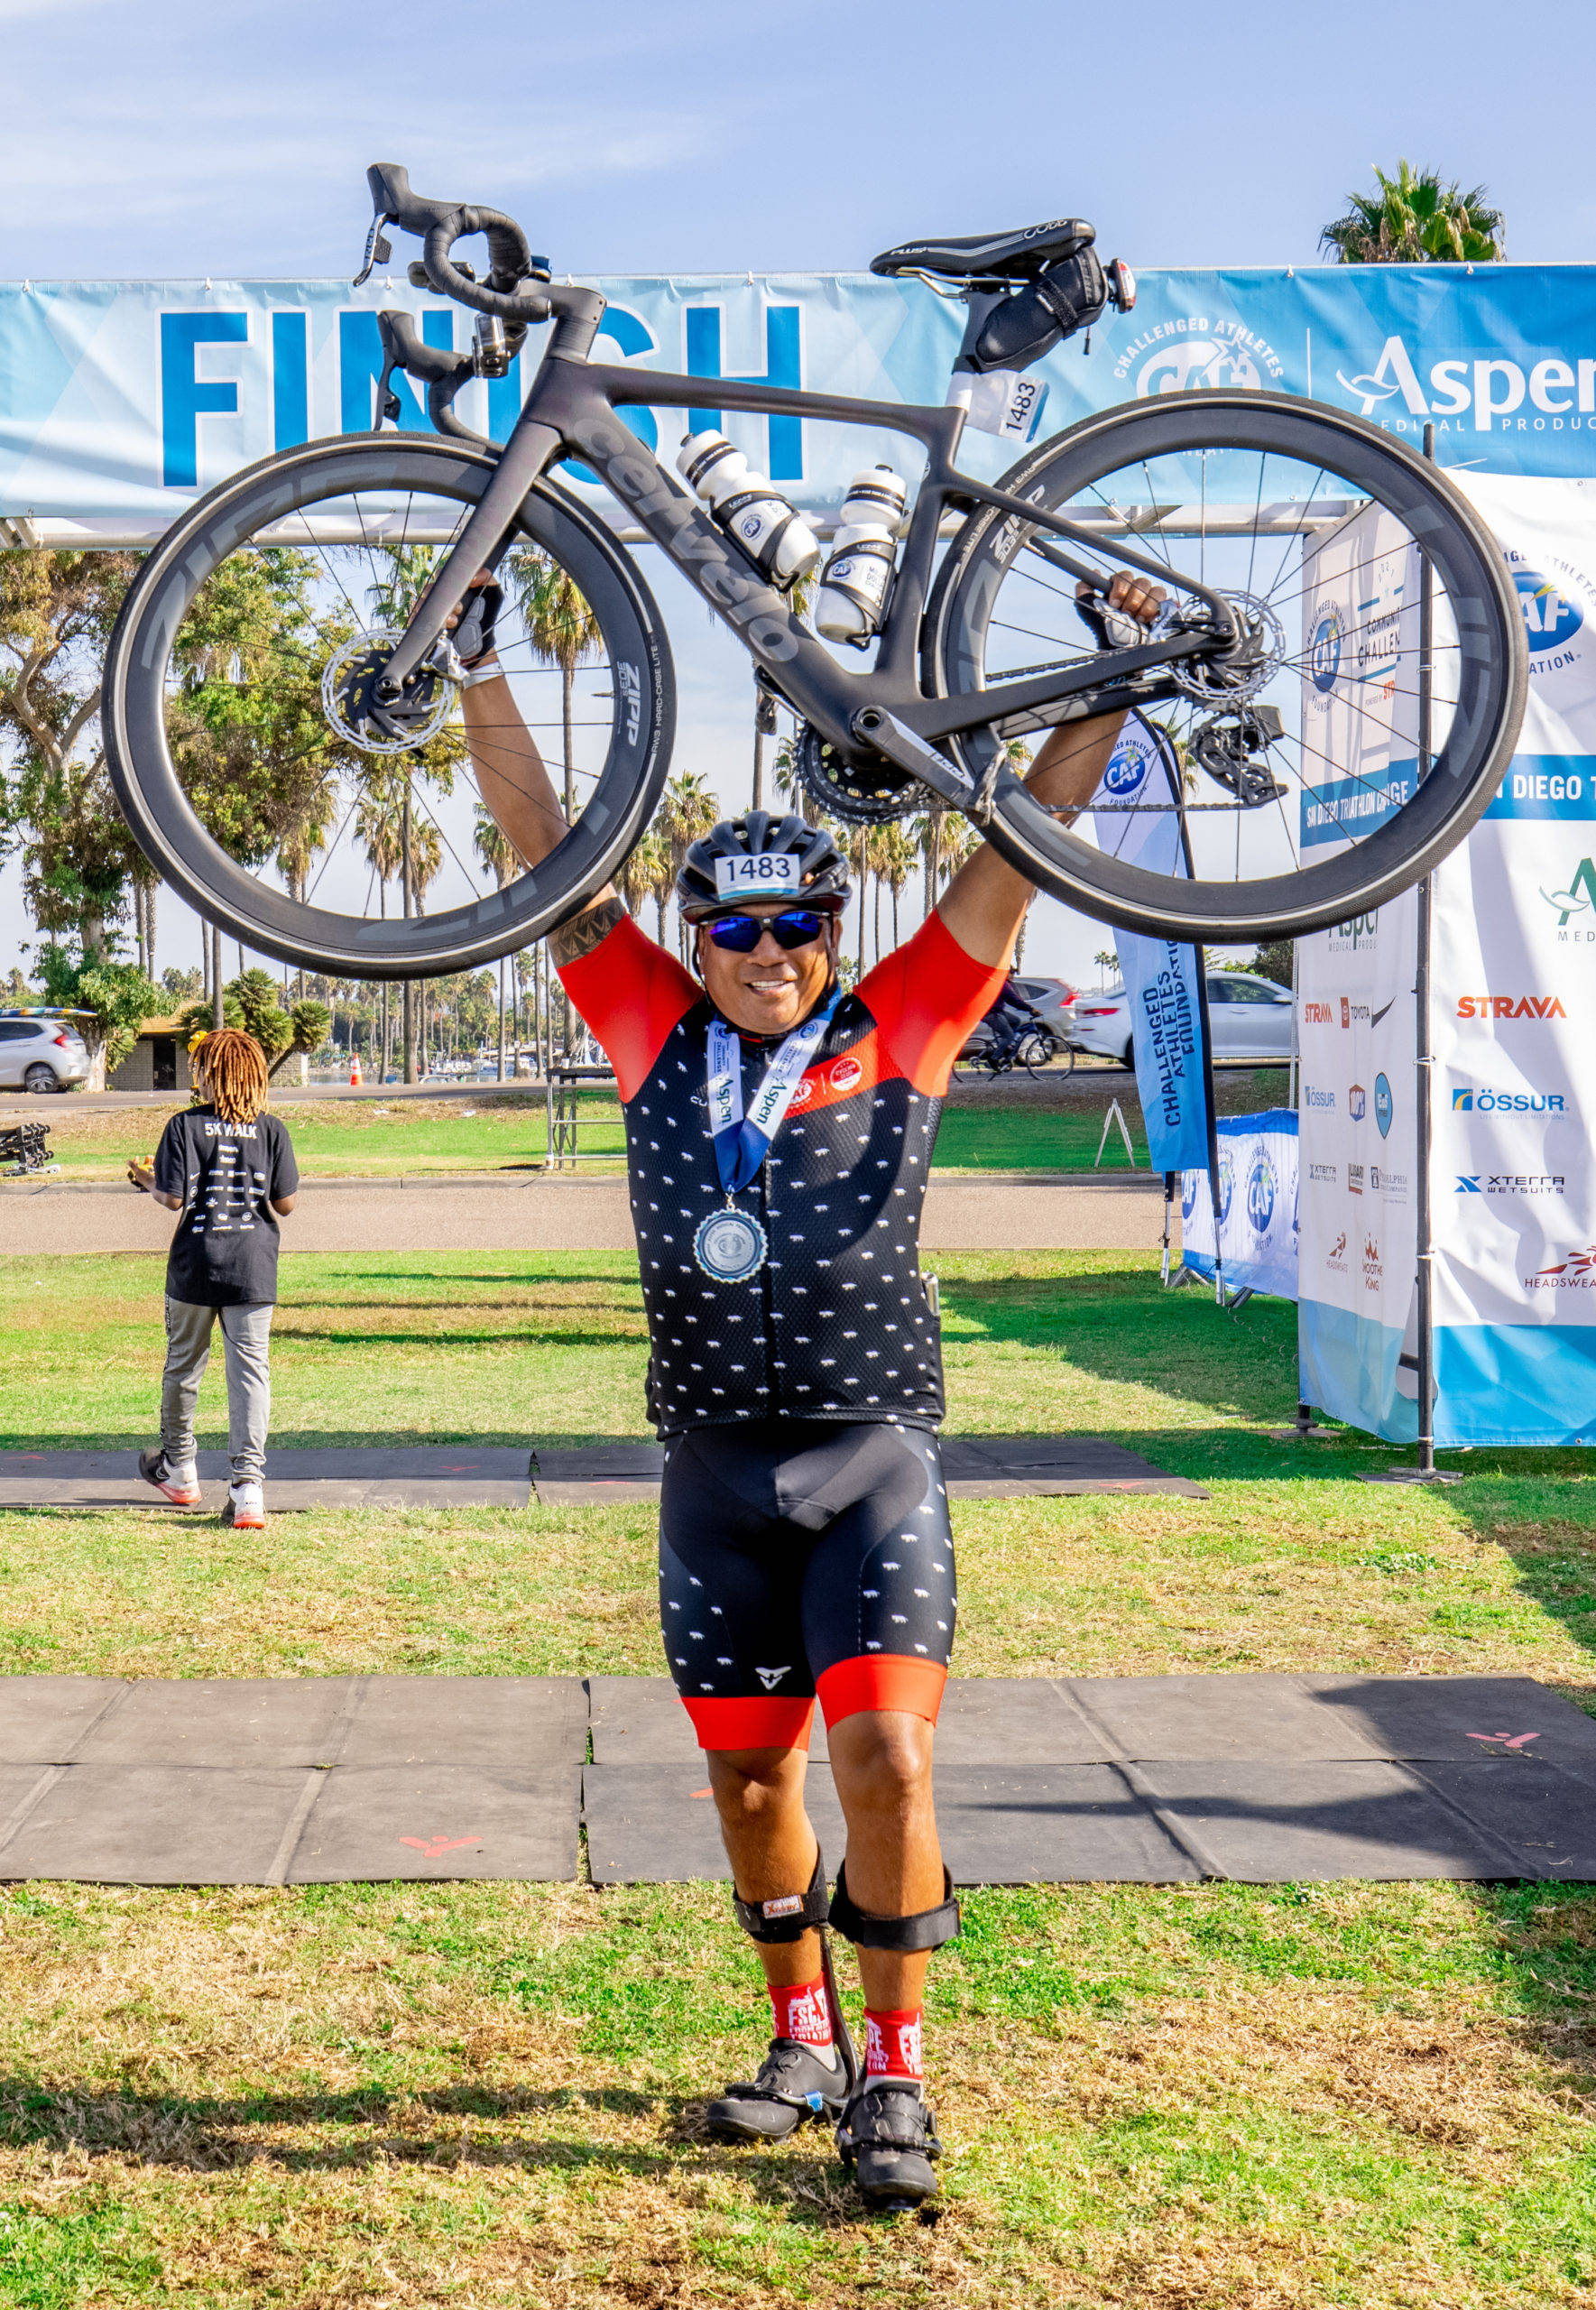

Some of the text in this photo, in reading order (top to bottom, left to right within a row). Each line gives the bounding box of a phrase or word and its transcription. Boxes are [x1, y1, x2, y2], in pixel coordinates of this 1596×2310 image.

[1113, 318, 1284, 379] CHALLENGED ATHLETES
[1006, 382, 1036, 430] 1483
[1518, 591, 1570, 633] AF
[650, 644, 661, 665] LITE
[625, 661, 641, 747] ZIPP
[654, 667, 664, 727] HARD-CASE
[1106, 756, 1140, 789] CAF
[1513, 773, 1582, 801] DIEGO
[1317, 799, 1339, 825] DIEGO
[1340, 790, 1376, 821] TRIATHLON
[726, 857, 791, 882] 1483
[1158, 970, 1186, 1078] ATHLETES
[1351, 1005, 1370, 1021] TOYOTA
[1456, 995, 1568, 1020] STRAVA
[1142, 987, 1182, 1127] CHALLENGED
[716, 1078, 734, 1123] Aspen
[756, 1081, 788, 1124] Aspen
[1311, 1086, 1335, 1107] ÖSSUR
[1477, 1088, 1565, 1112] ÖSSUR
[204, 1123, 257, 1140] 5K WALK
[1525, 1113, 1565, 1122] LIMITATIONS
[1248, 1177, 1273, 1216] CAF
